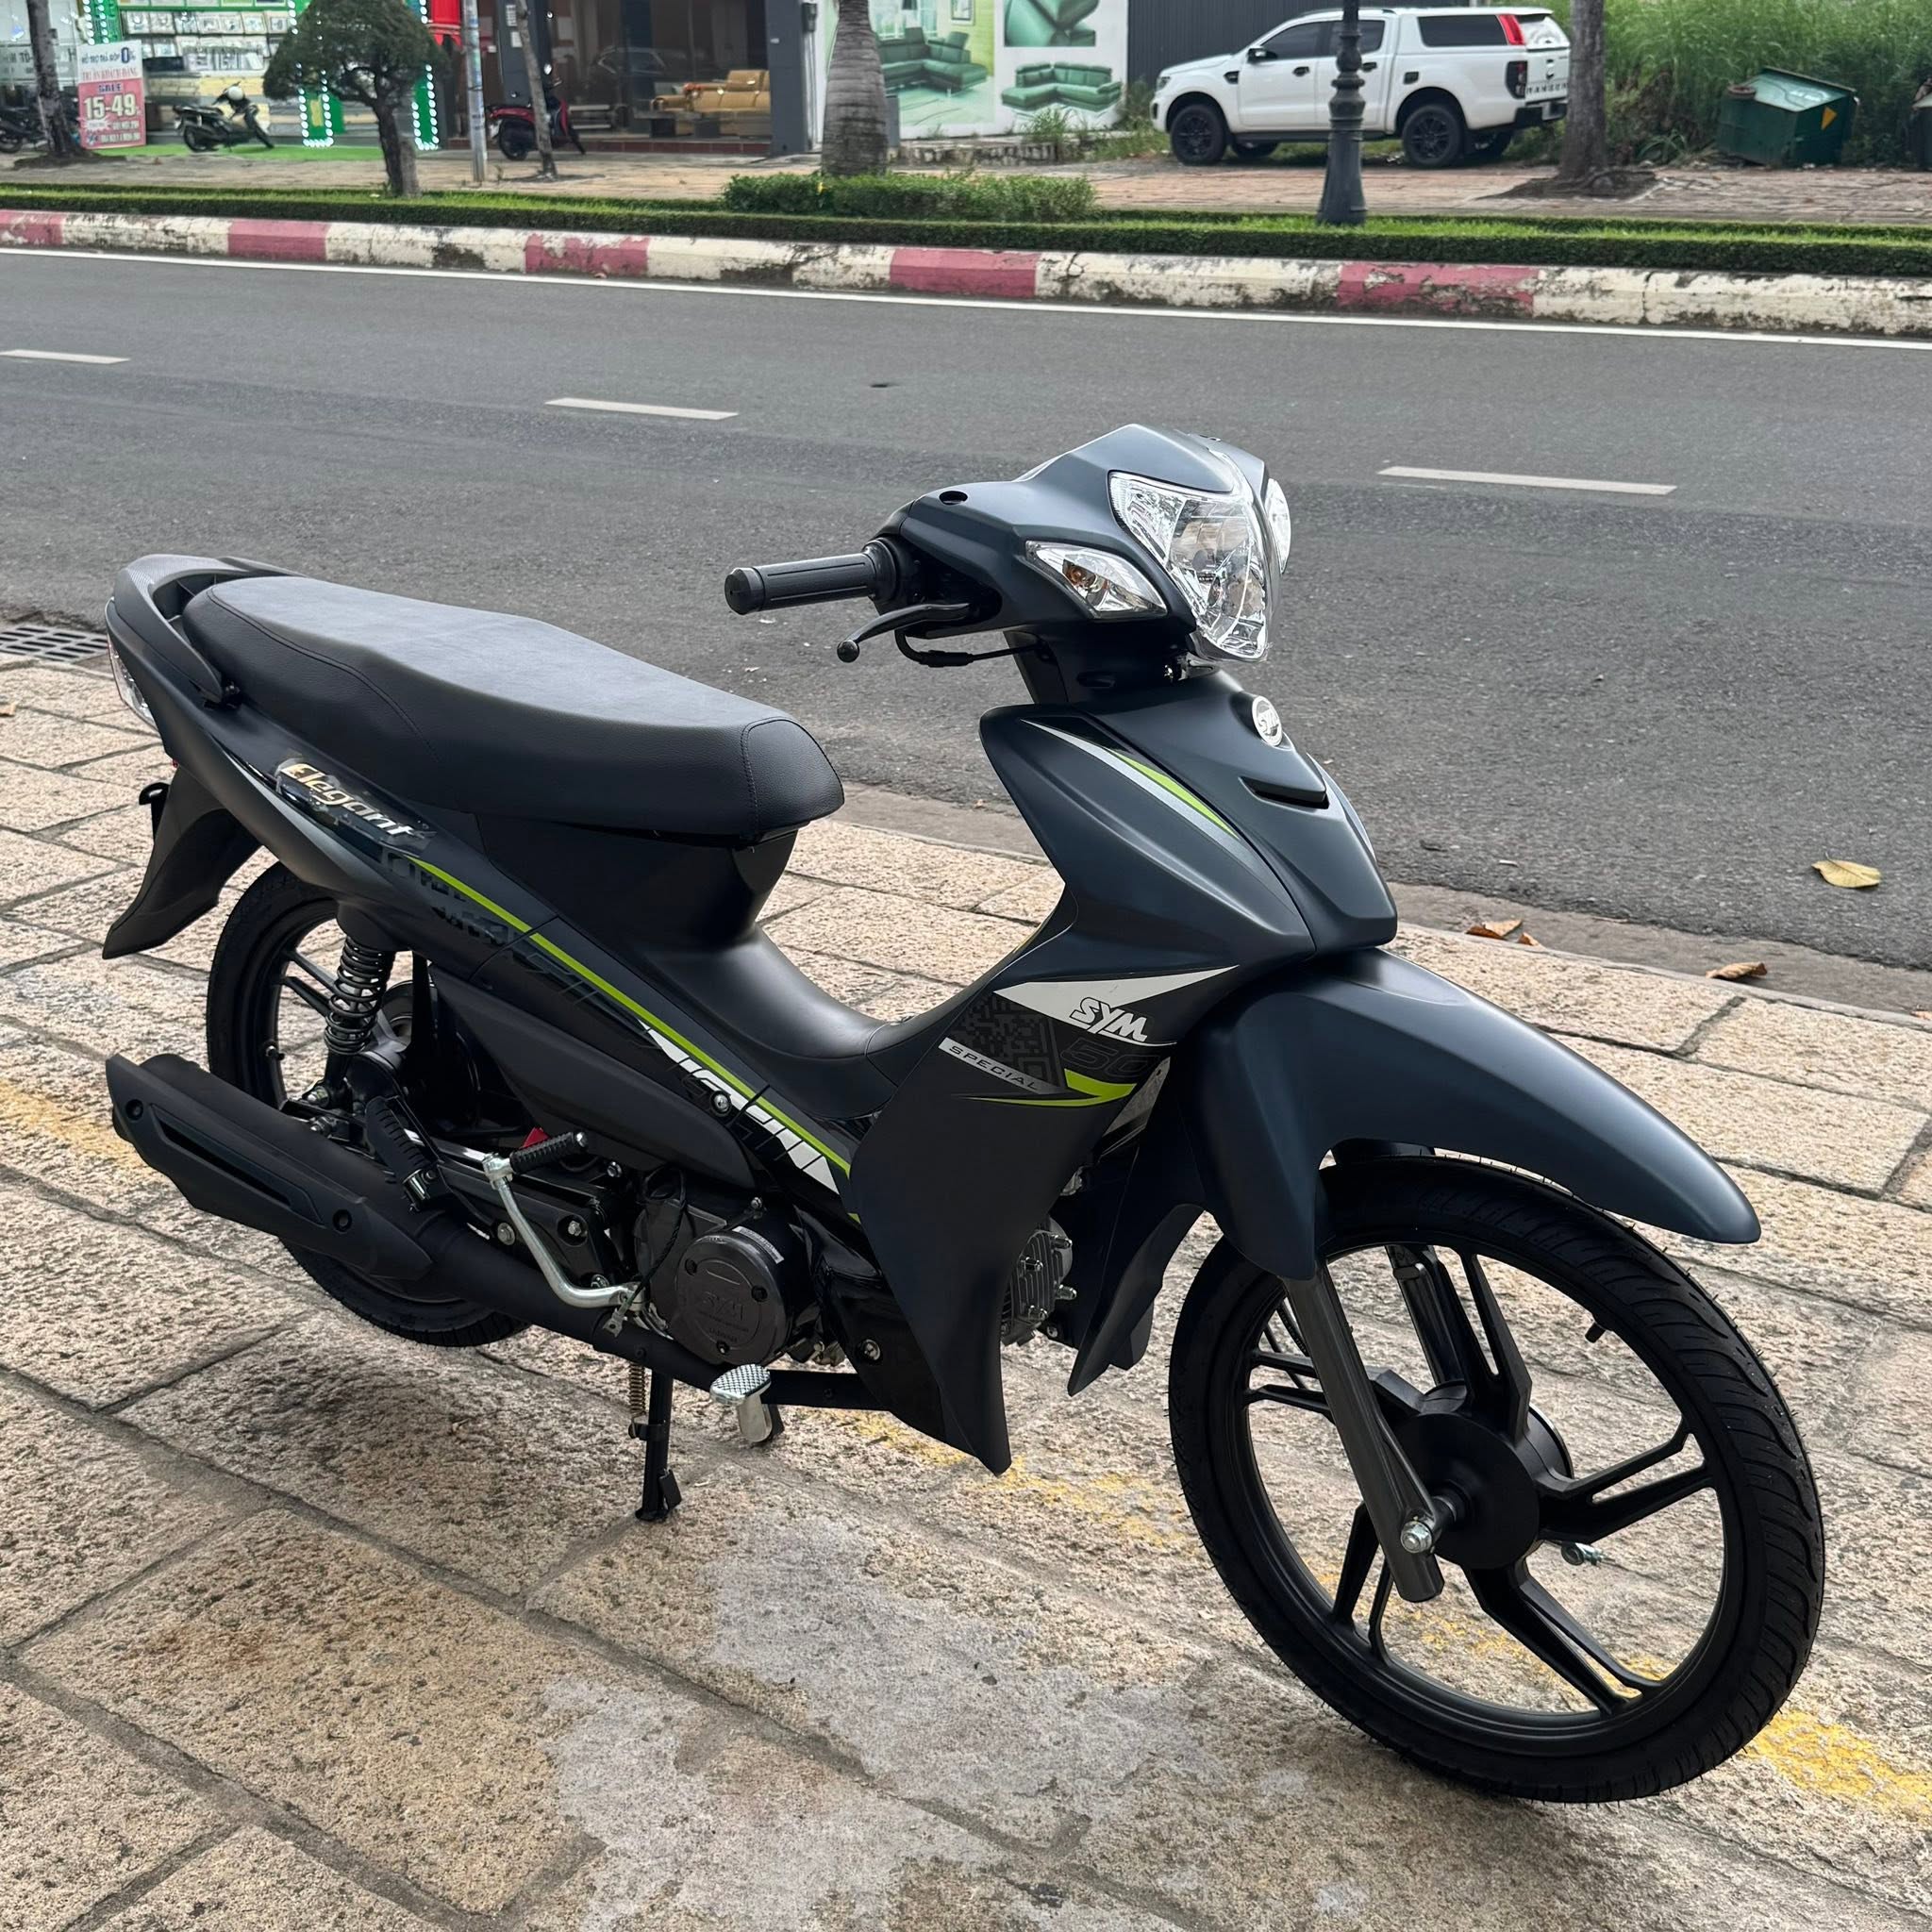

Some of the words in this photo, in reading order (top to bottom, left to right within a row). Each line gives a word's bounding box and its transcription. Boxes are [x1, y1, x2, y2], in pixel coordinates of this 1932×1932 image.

[280, 762, 425, 841] Elegant
[1068, 996, 1149, 1043] SYM
[948, 1044, 1044, 1091] SPECIAL
